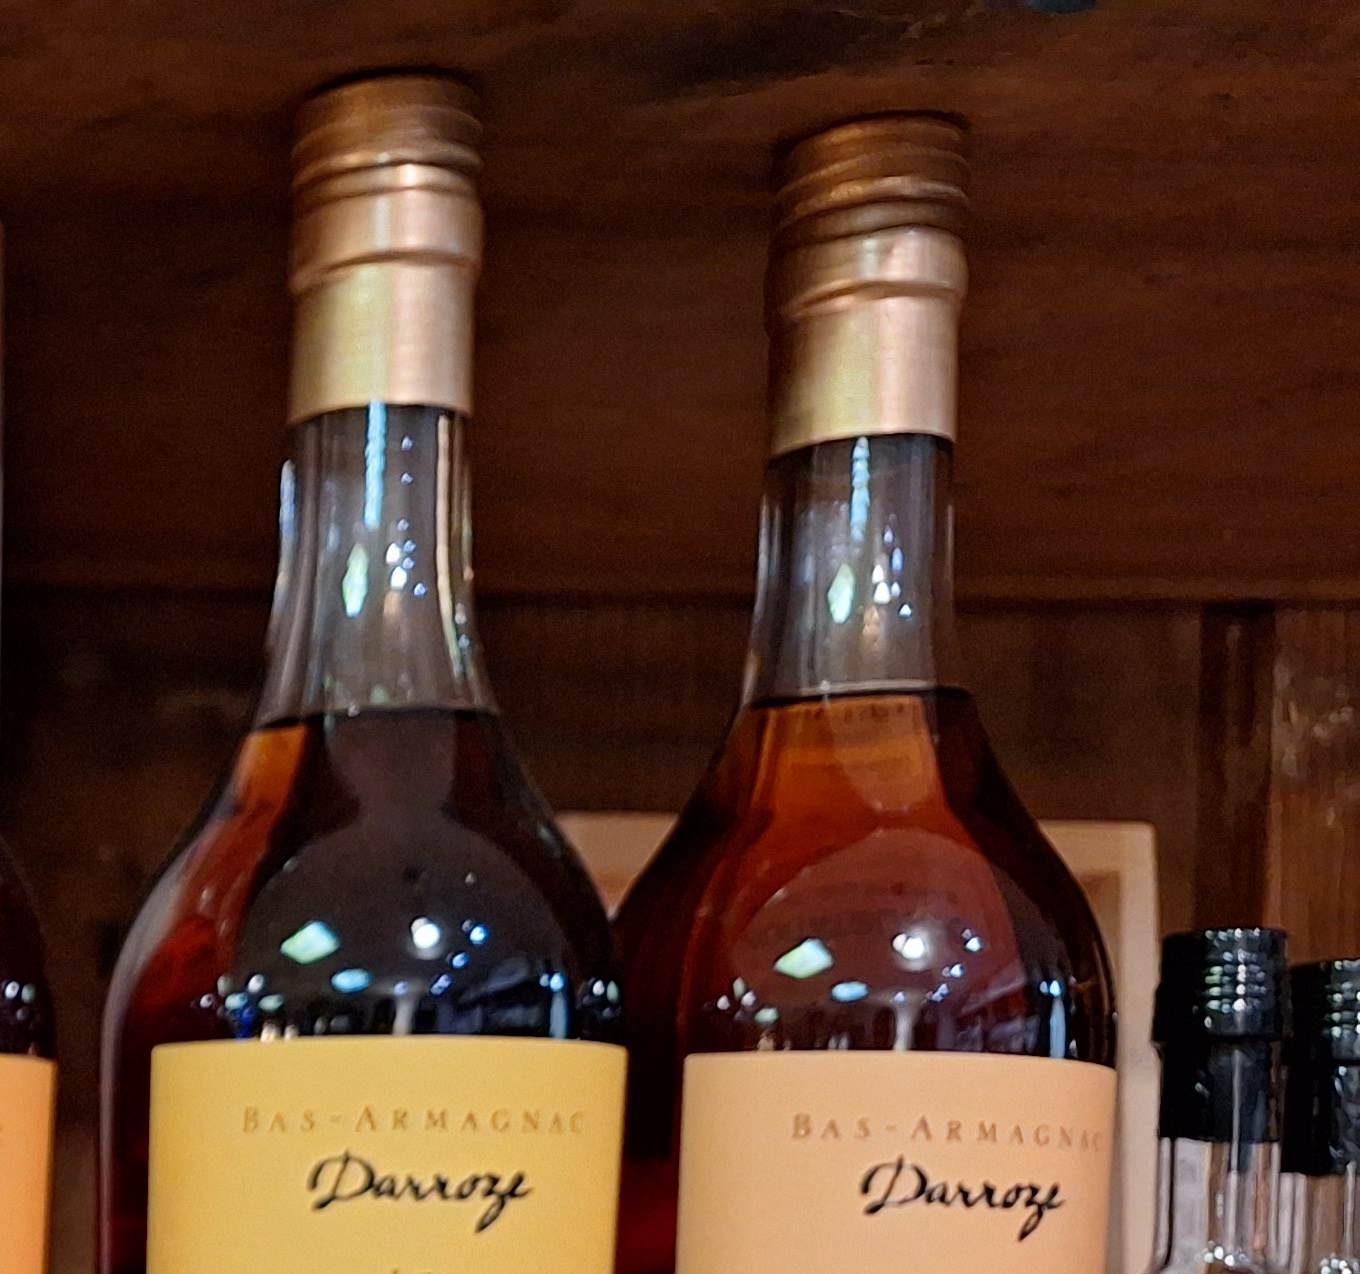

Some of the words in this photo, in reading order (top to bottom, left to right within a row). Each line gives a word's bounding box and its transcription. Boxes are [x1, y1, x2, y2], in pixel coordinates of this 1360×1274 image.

[242, 1105, 583, 1135] BAS-ARMAGNAC
[791, 1113, 1104, 1152] BAS-ARMAGNAC
[307, 1149, 533, 1234] Darroze
[859, 1155, 1065, 1243] Darroze
